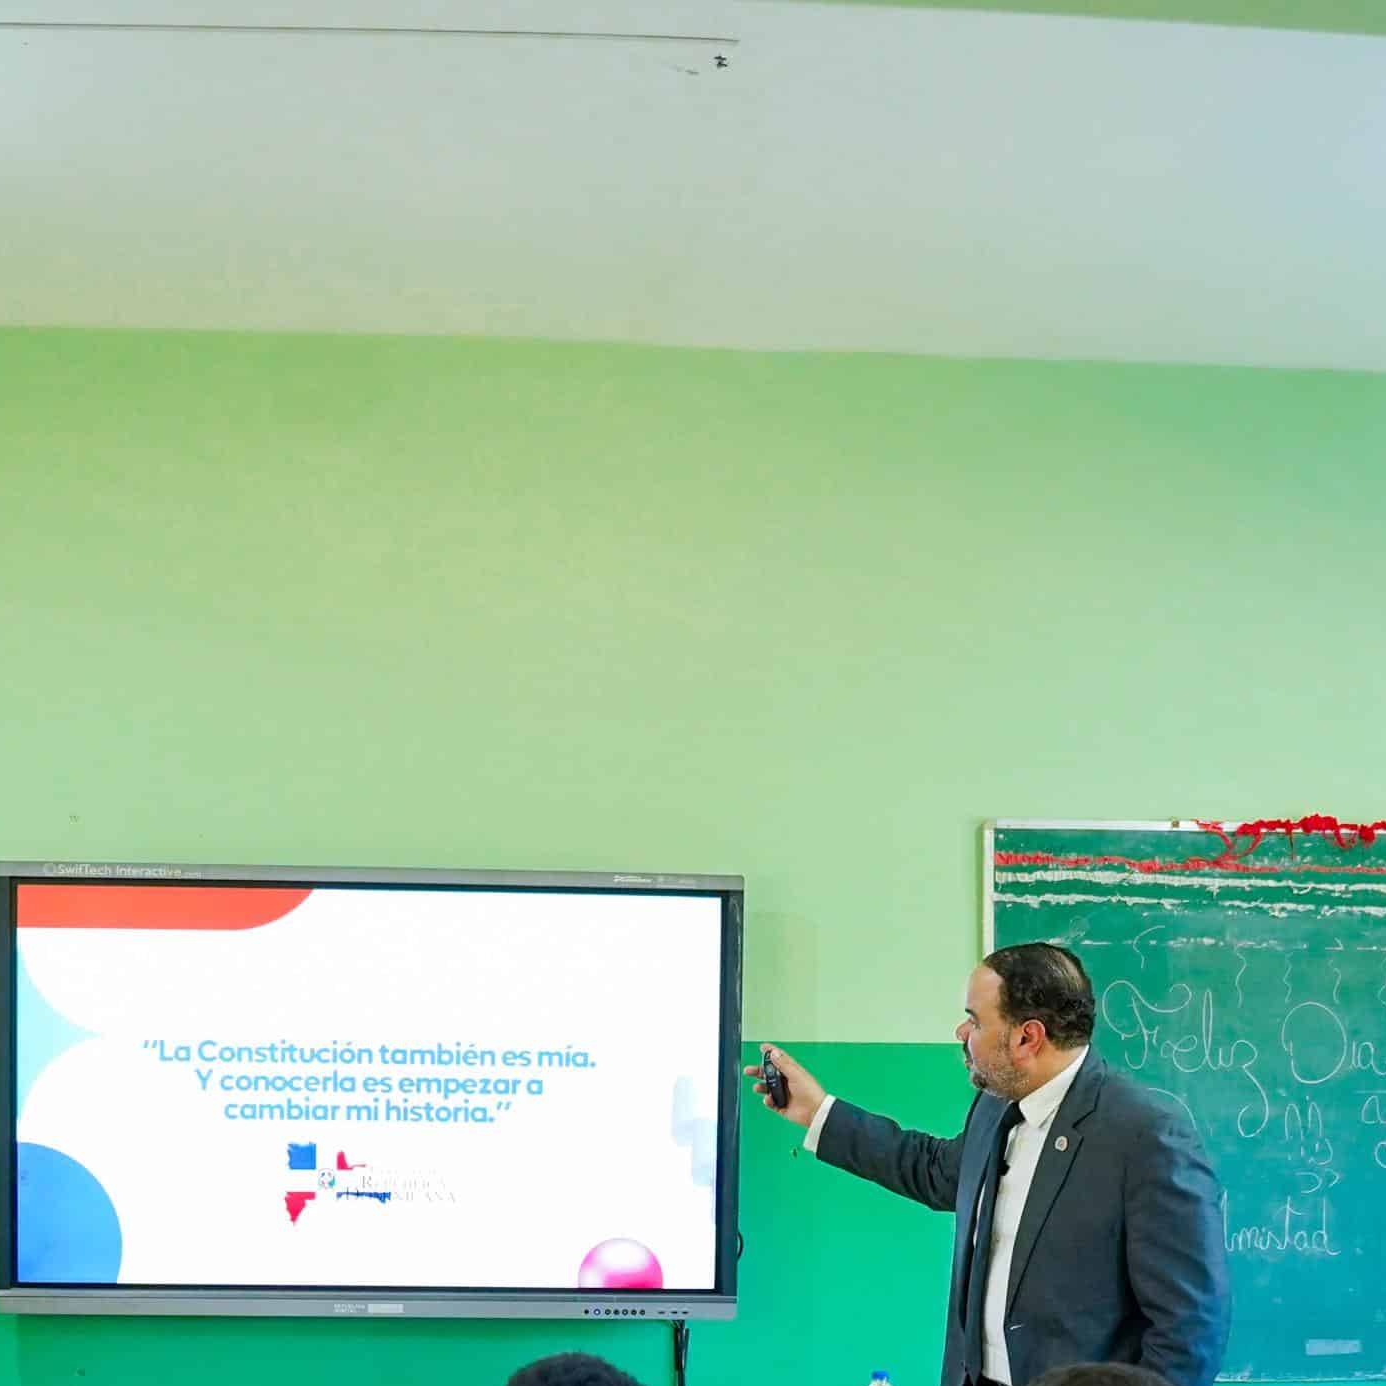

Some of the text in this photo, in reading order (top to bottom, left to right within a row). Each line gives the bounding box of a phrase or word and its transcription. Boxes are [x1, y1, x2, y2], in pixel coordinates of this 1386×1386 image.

[194, 1038, 374, 1067] Constitución
[378, 1040, 497, 1068] también
[500, 1049, 533, 1068] es
[536, 1044, 598, 1069] mía.
[193, 1068, 545, 1101] Y conocerla es empezar a
[223, 1096, 342, 1121] cambiar
[344, 1096, 381, 1122] mi
